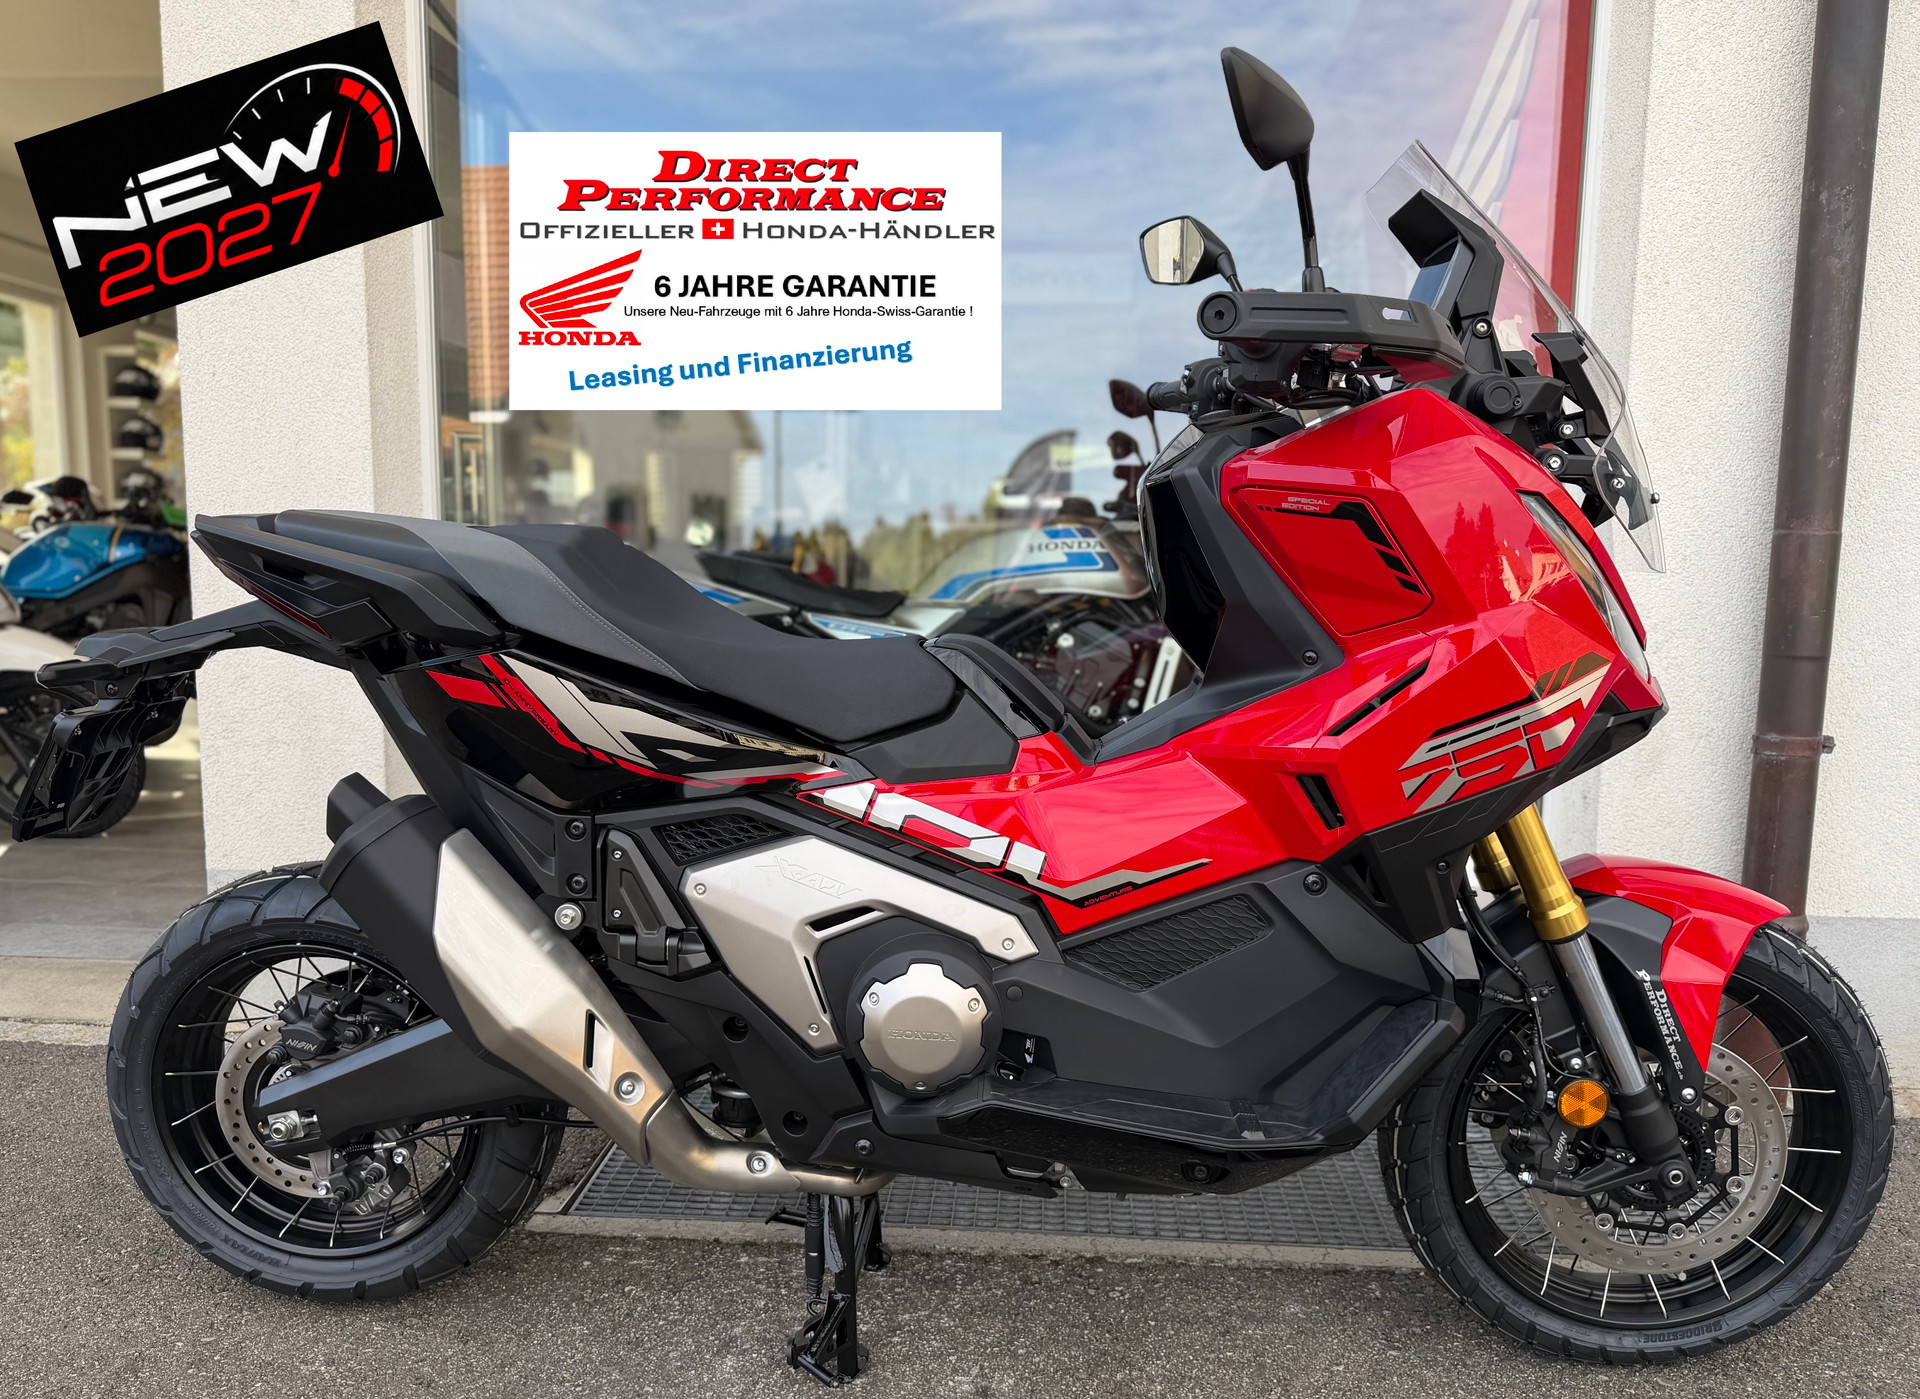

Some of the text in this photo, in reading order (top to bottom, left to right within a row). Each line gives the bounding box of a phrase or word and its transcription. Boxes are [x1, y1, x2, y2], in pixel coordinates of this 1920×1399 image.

[1281, 502, 1320, 511] EDITION
[1287, 496, 1331, 506] SPECIAL
[1028, 540, 1106, 554] HONDA
[1083, 886, 1134, 907] ADVENTURE
[1655, 988, 1682, 1043] DIRECT
[887, 1028, 957, 1042] HONDA
